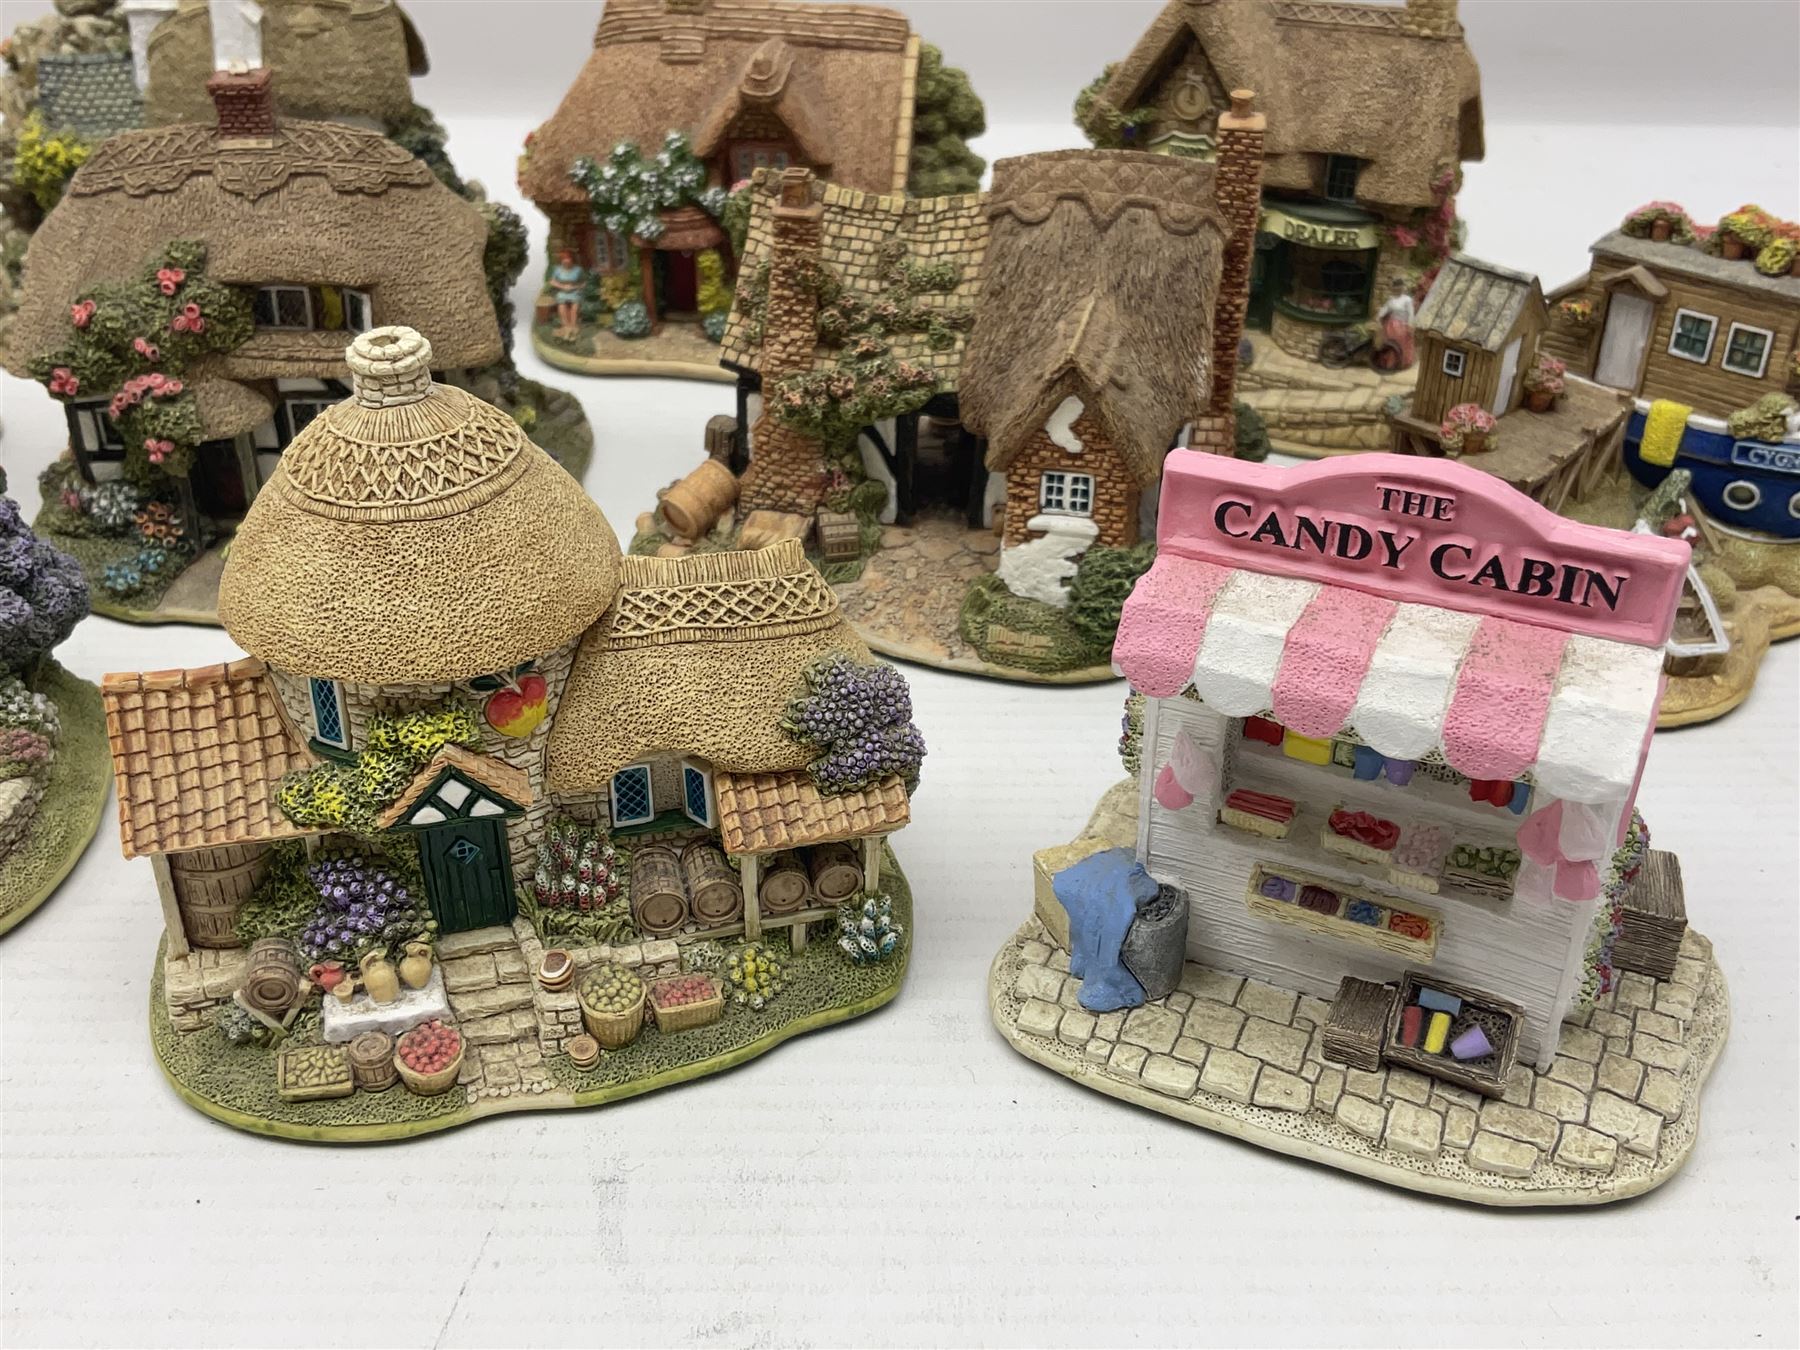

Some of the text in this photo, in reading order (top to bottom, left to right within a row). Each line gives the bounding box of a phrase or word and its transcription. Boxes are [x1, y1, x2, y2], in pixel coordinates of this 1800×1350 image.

[1284, 220, 1360, 247] DEALER
[1377, 486, 1455, 522] THE
[1213, 500, 1629, 612] CANDY CABIN
